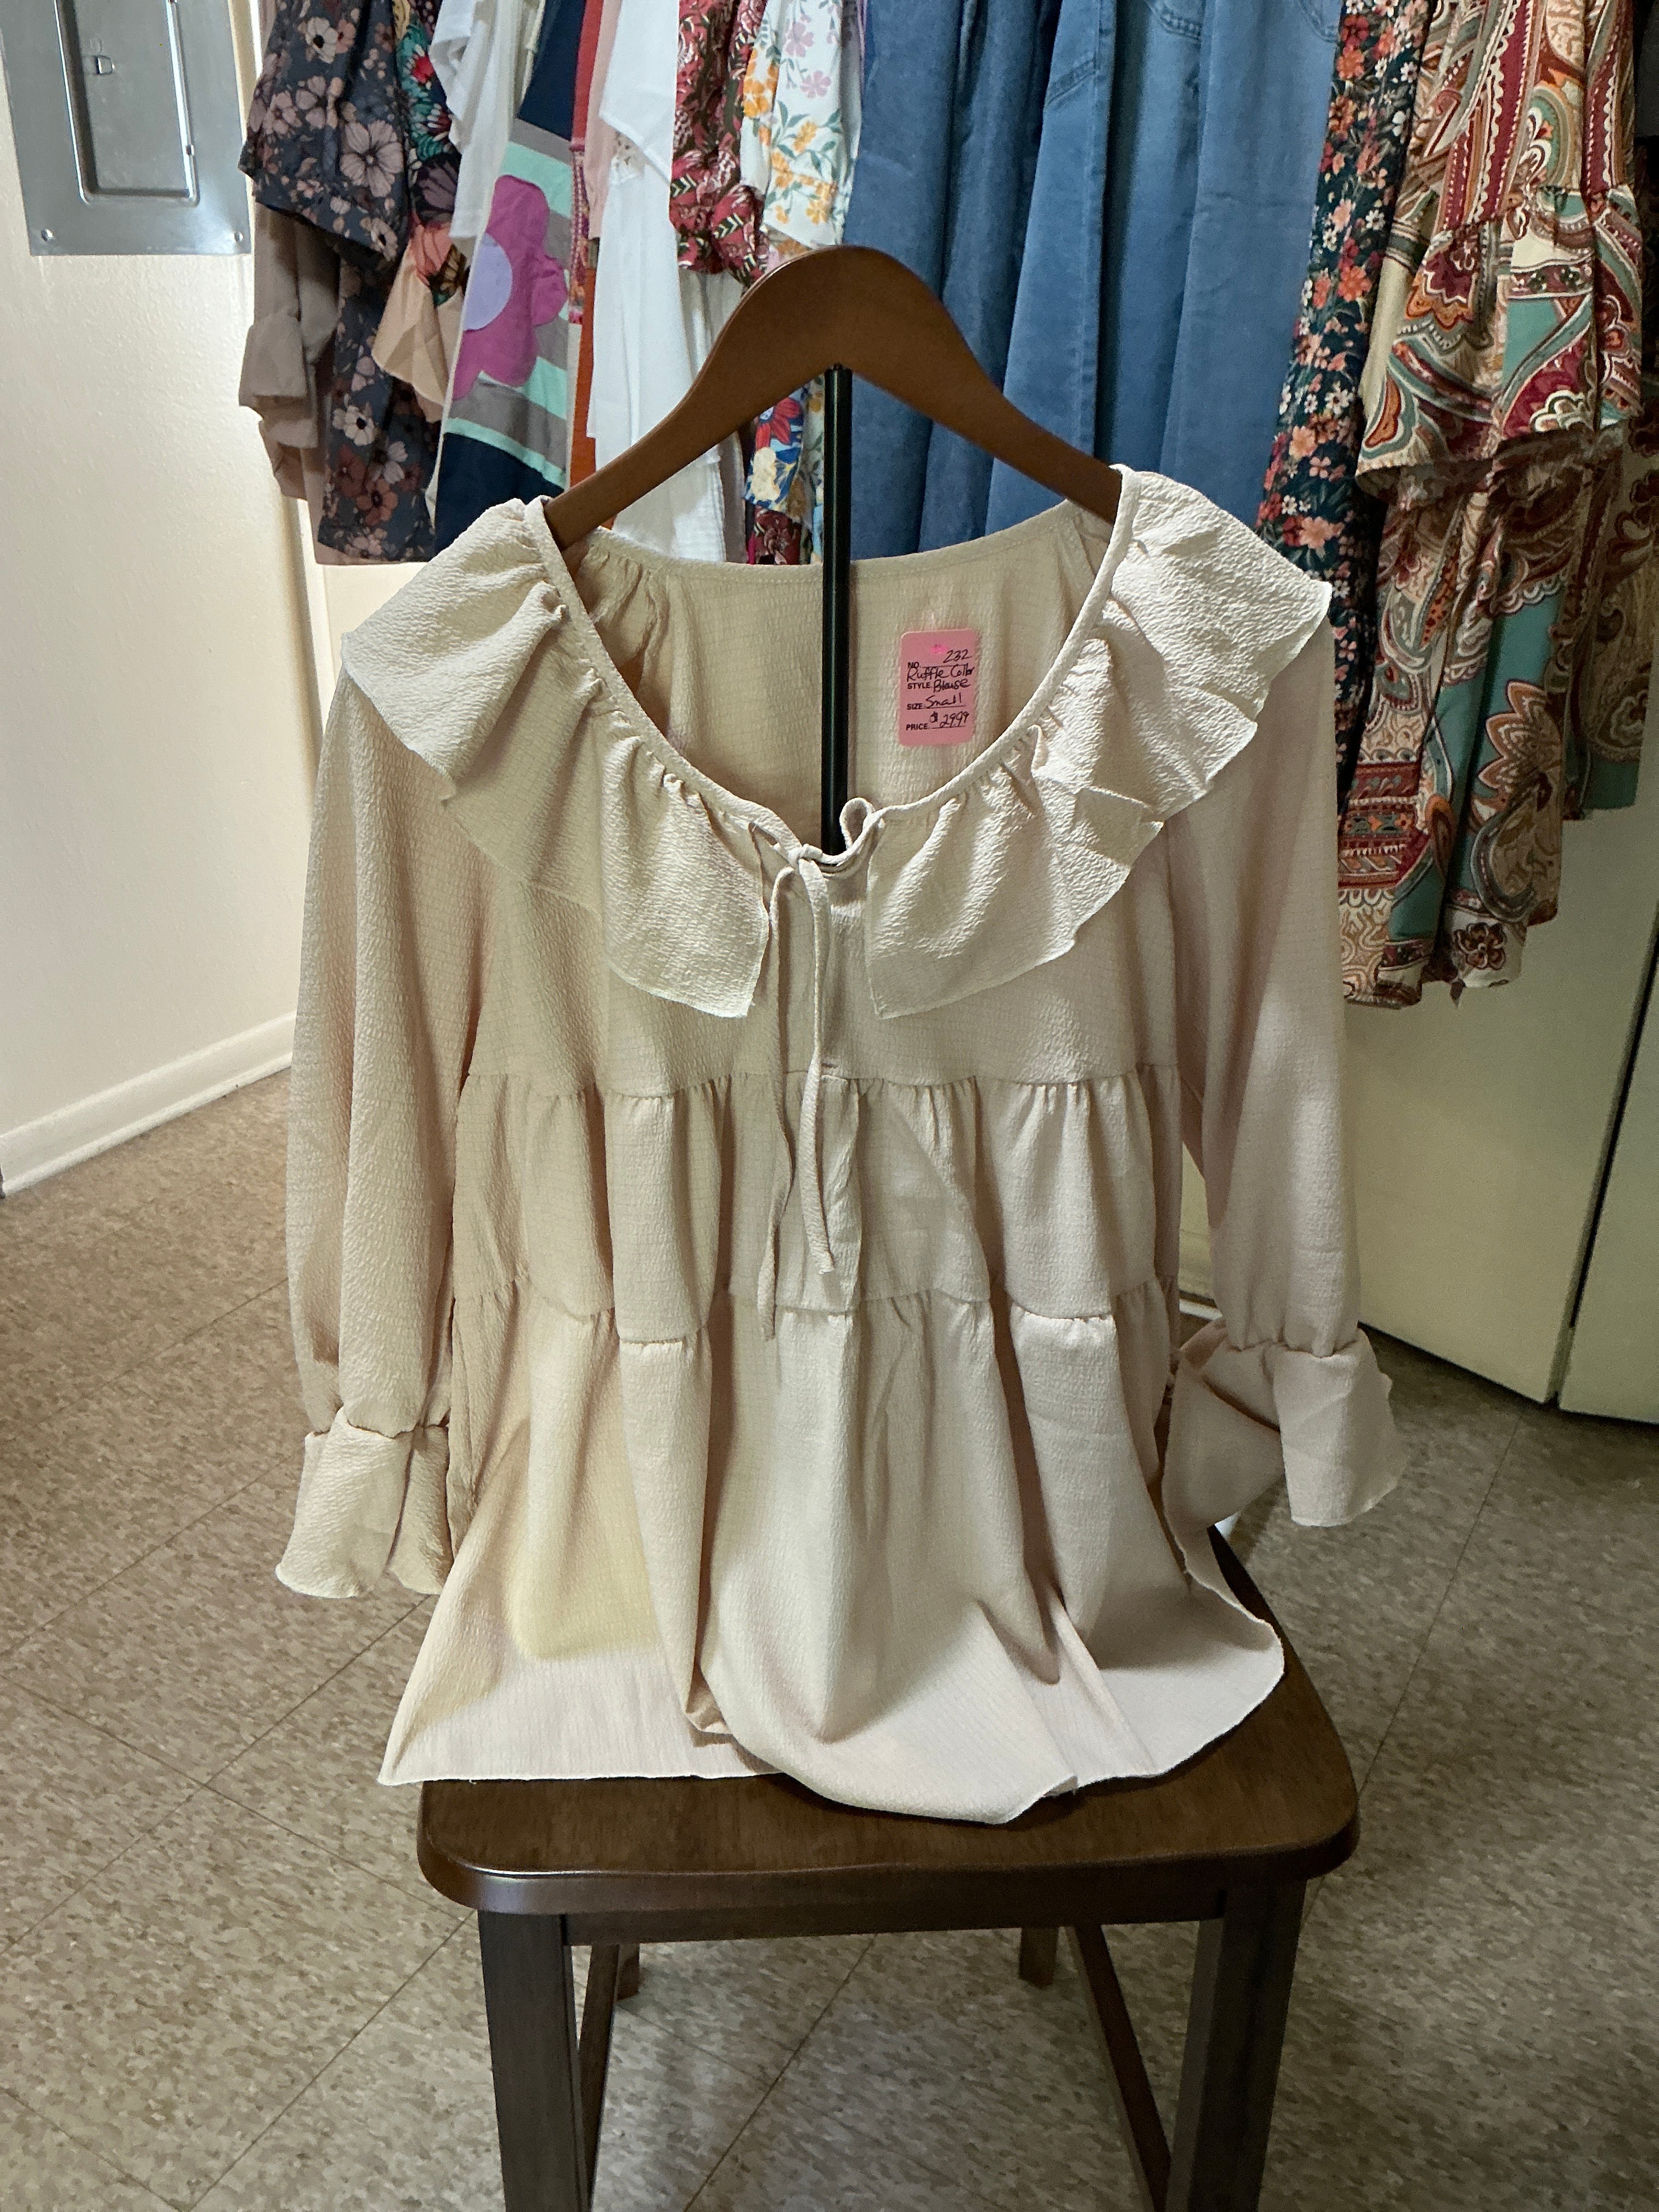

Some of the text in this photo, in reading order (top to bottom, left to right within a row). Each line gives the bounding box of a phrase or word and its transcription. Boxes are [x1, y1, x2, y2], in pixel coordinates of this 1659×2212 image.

[943, 649, 973, 663] 232
[907, 667, 949, 682] Ruffle
[925, 692, 962, 709] Small
